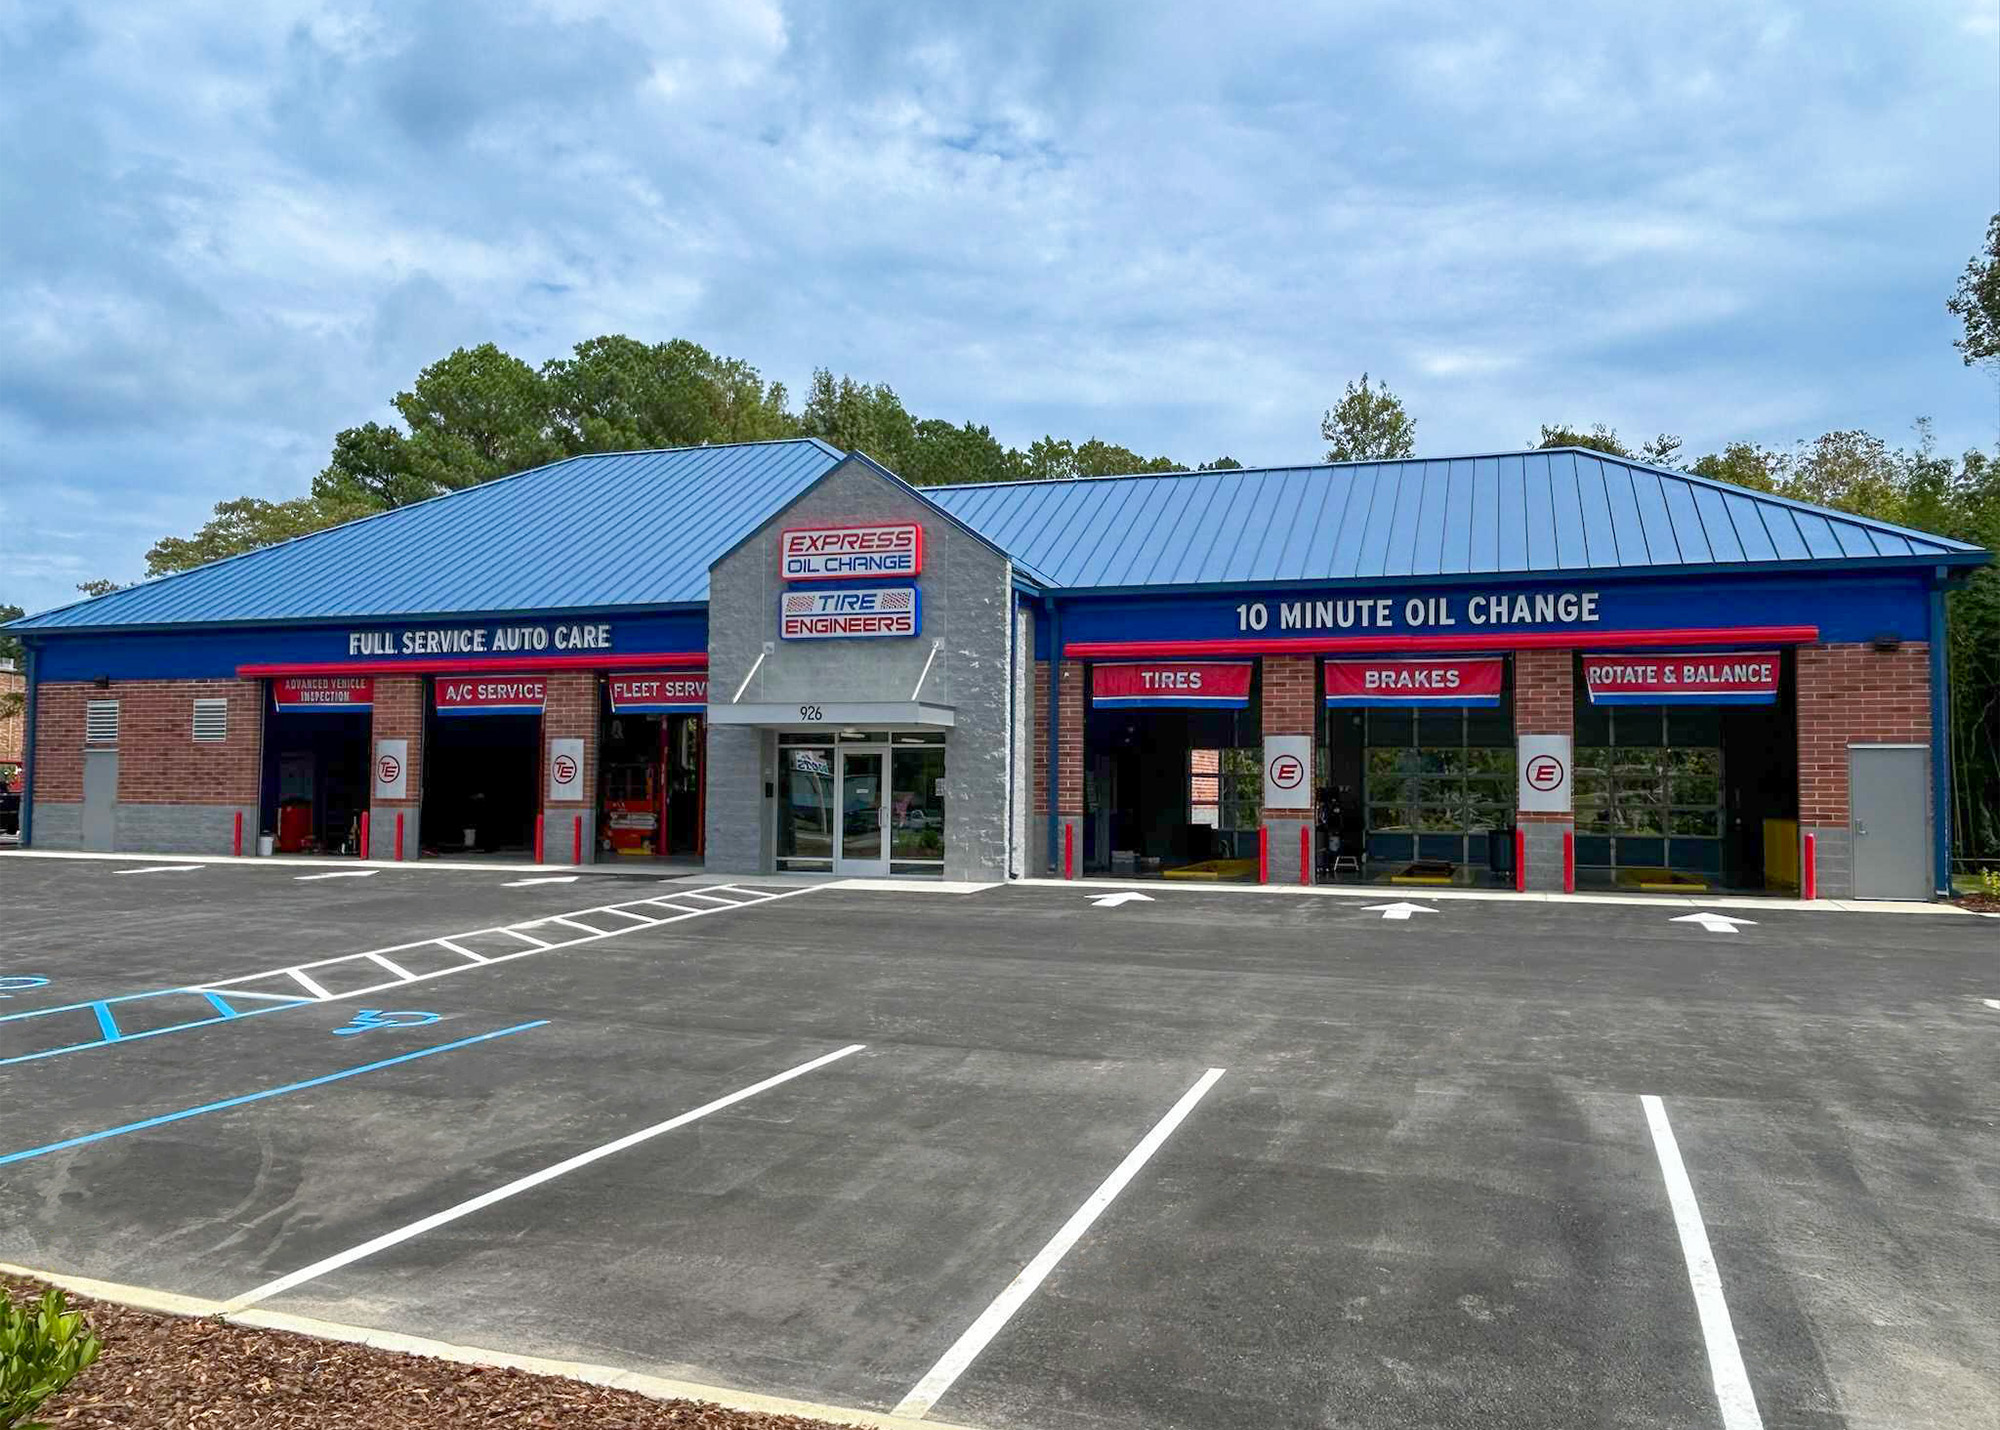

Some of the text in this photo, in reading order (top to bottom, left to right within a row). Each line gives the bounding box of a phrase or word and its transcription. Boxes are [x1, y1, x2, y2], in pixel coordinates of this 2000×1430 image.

[788, 531, 914, 553] EXPRESS
[787, 554, 912, 574] OIL CHANGE
[818, 593, 878, 611] TIRE
[1235, 592, 1600, 631] 10 MINUTE OIL CHANGE
[785, 616, 912, 635] ENGINEERS
[349, 624, 613, 655] FULL SERVICE AUTO CARE
[1141, 671, 1203, 689] TIRES
[1365, 669, 1460, 689] BRAKES
[1589, 664, 1772, 684] ROTATE & BALANCE
[285, 677, 367, 690] ADVANCED VEHICLE
[446, 683, 544, 701] A/C SERVICE
[614, 682, 660, 698] FLEET
[300, 690, 350, 702] INSPECTION
[800, 705, 823, 721] 926
